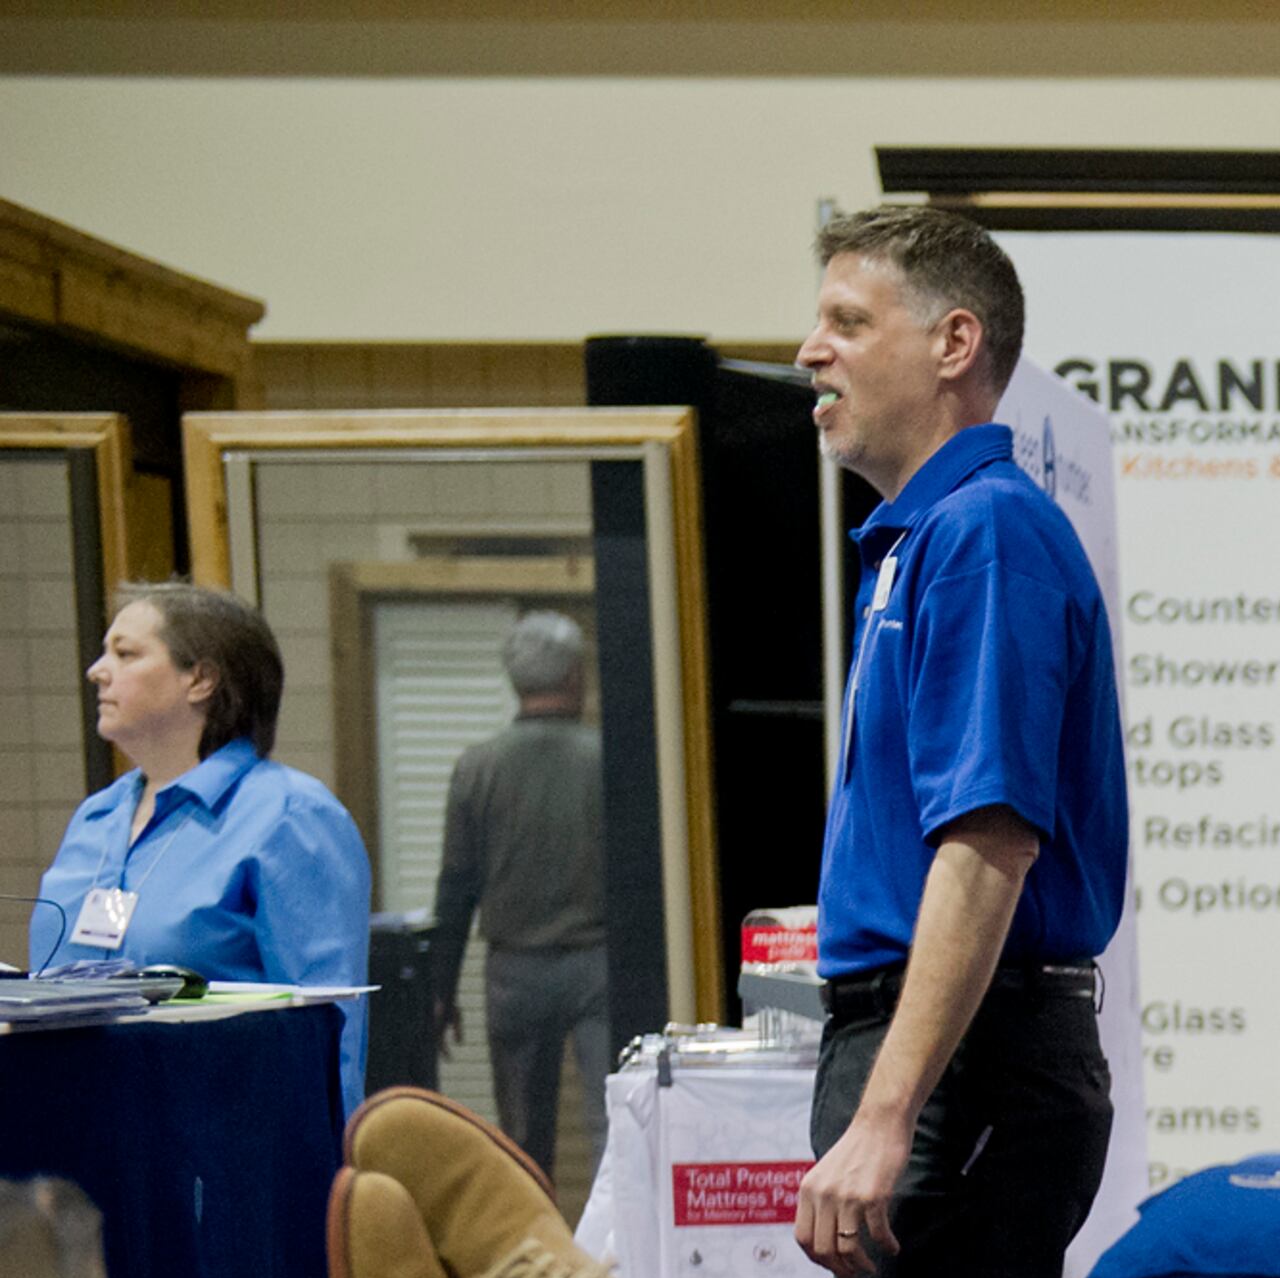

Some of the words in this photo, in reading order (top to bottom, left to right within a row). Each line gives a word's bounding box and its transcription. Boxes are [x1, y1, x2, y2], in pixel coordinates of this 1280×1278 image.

[1121, 453, 1258, 480] Kitchens
[1129, 653, 1280, 687] Shower
[1168, 715, 1275, 748] Glass
[1141, 1001, 1246, 1034] Glass
[686, 1167, 731, 1188] Total
[687, 1188, 767, 1209] Mattress
